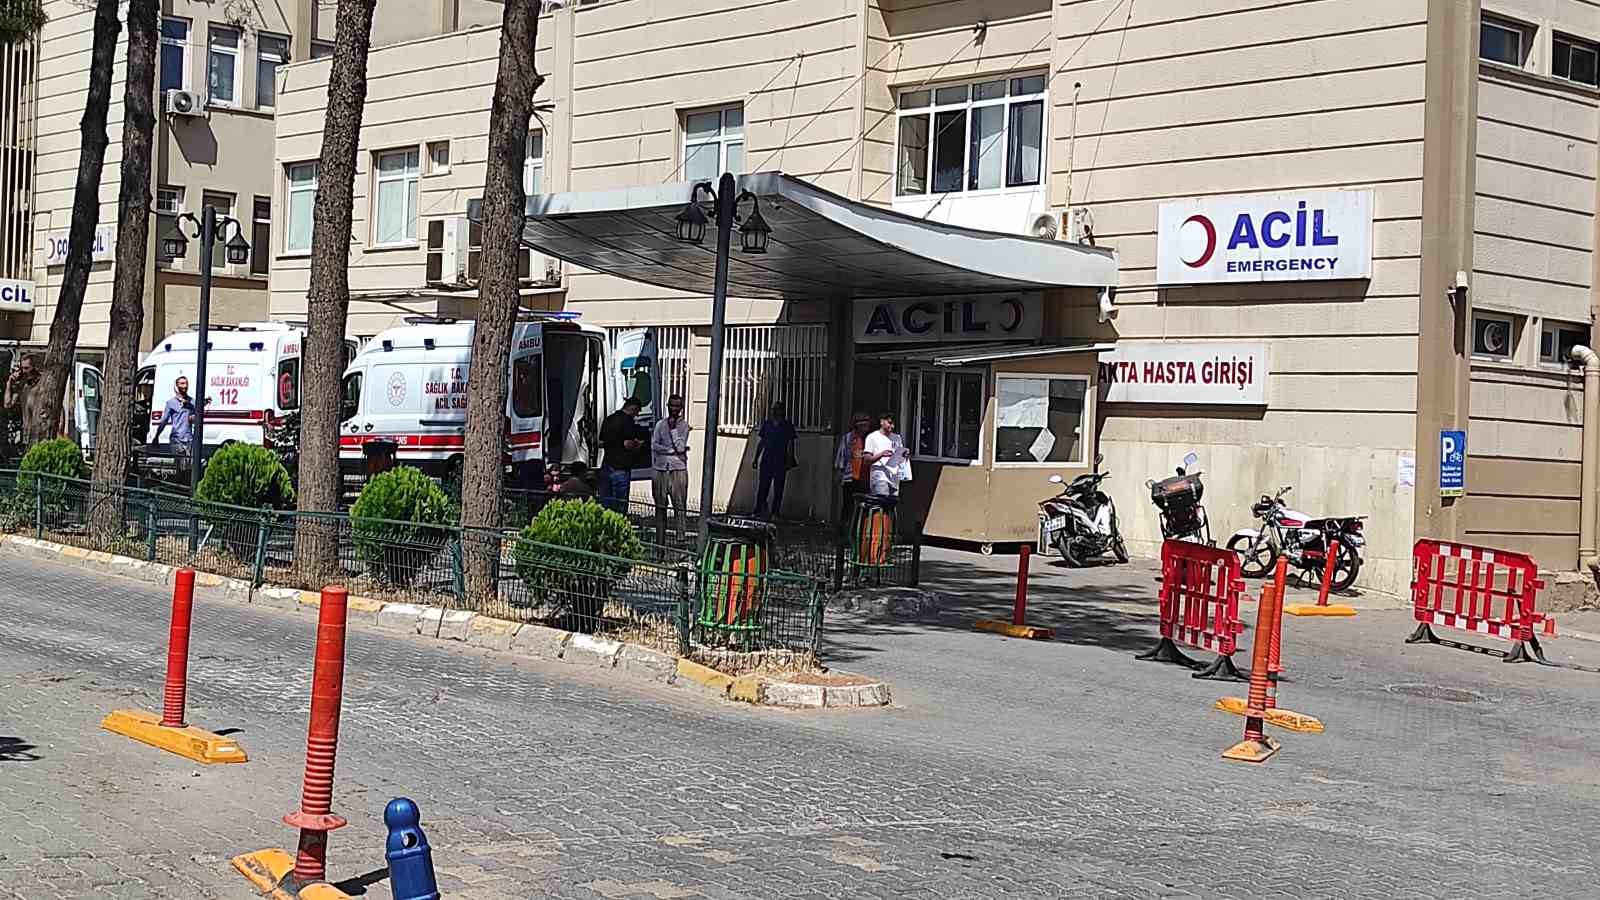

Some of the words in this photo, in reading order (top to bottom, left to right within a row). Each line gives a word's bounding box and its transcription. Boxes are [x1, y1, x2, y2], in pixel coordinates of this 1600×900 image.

[1227, 200, 1339, 250] ACİL
[91, 231, 105, 253] CİL
[1226, 257, 1338, 273] EMERGENCY
[1, 284, 32, 303] CİL
[864, 299, 986, 335] ACİL
[1097, 361, 1138, 384] AKTA
[1143, 361, 1196, 384] HASTA
[1201, 355, 1253, 390] GİRİŞİ
[219, 388, 239, 405] 112
[451, 394, 468, 409] SAĞ
[1442, 436, 1455, 463] P
